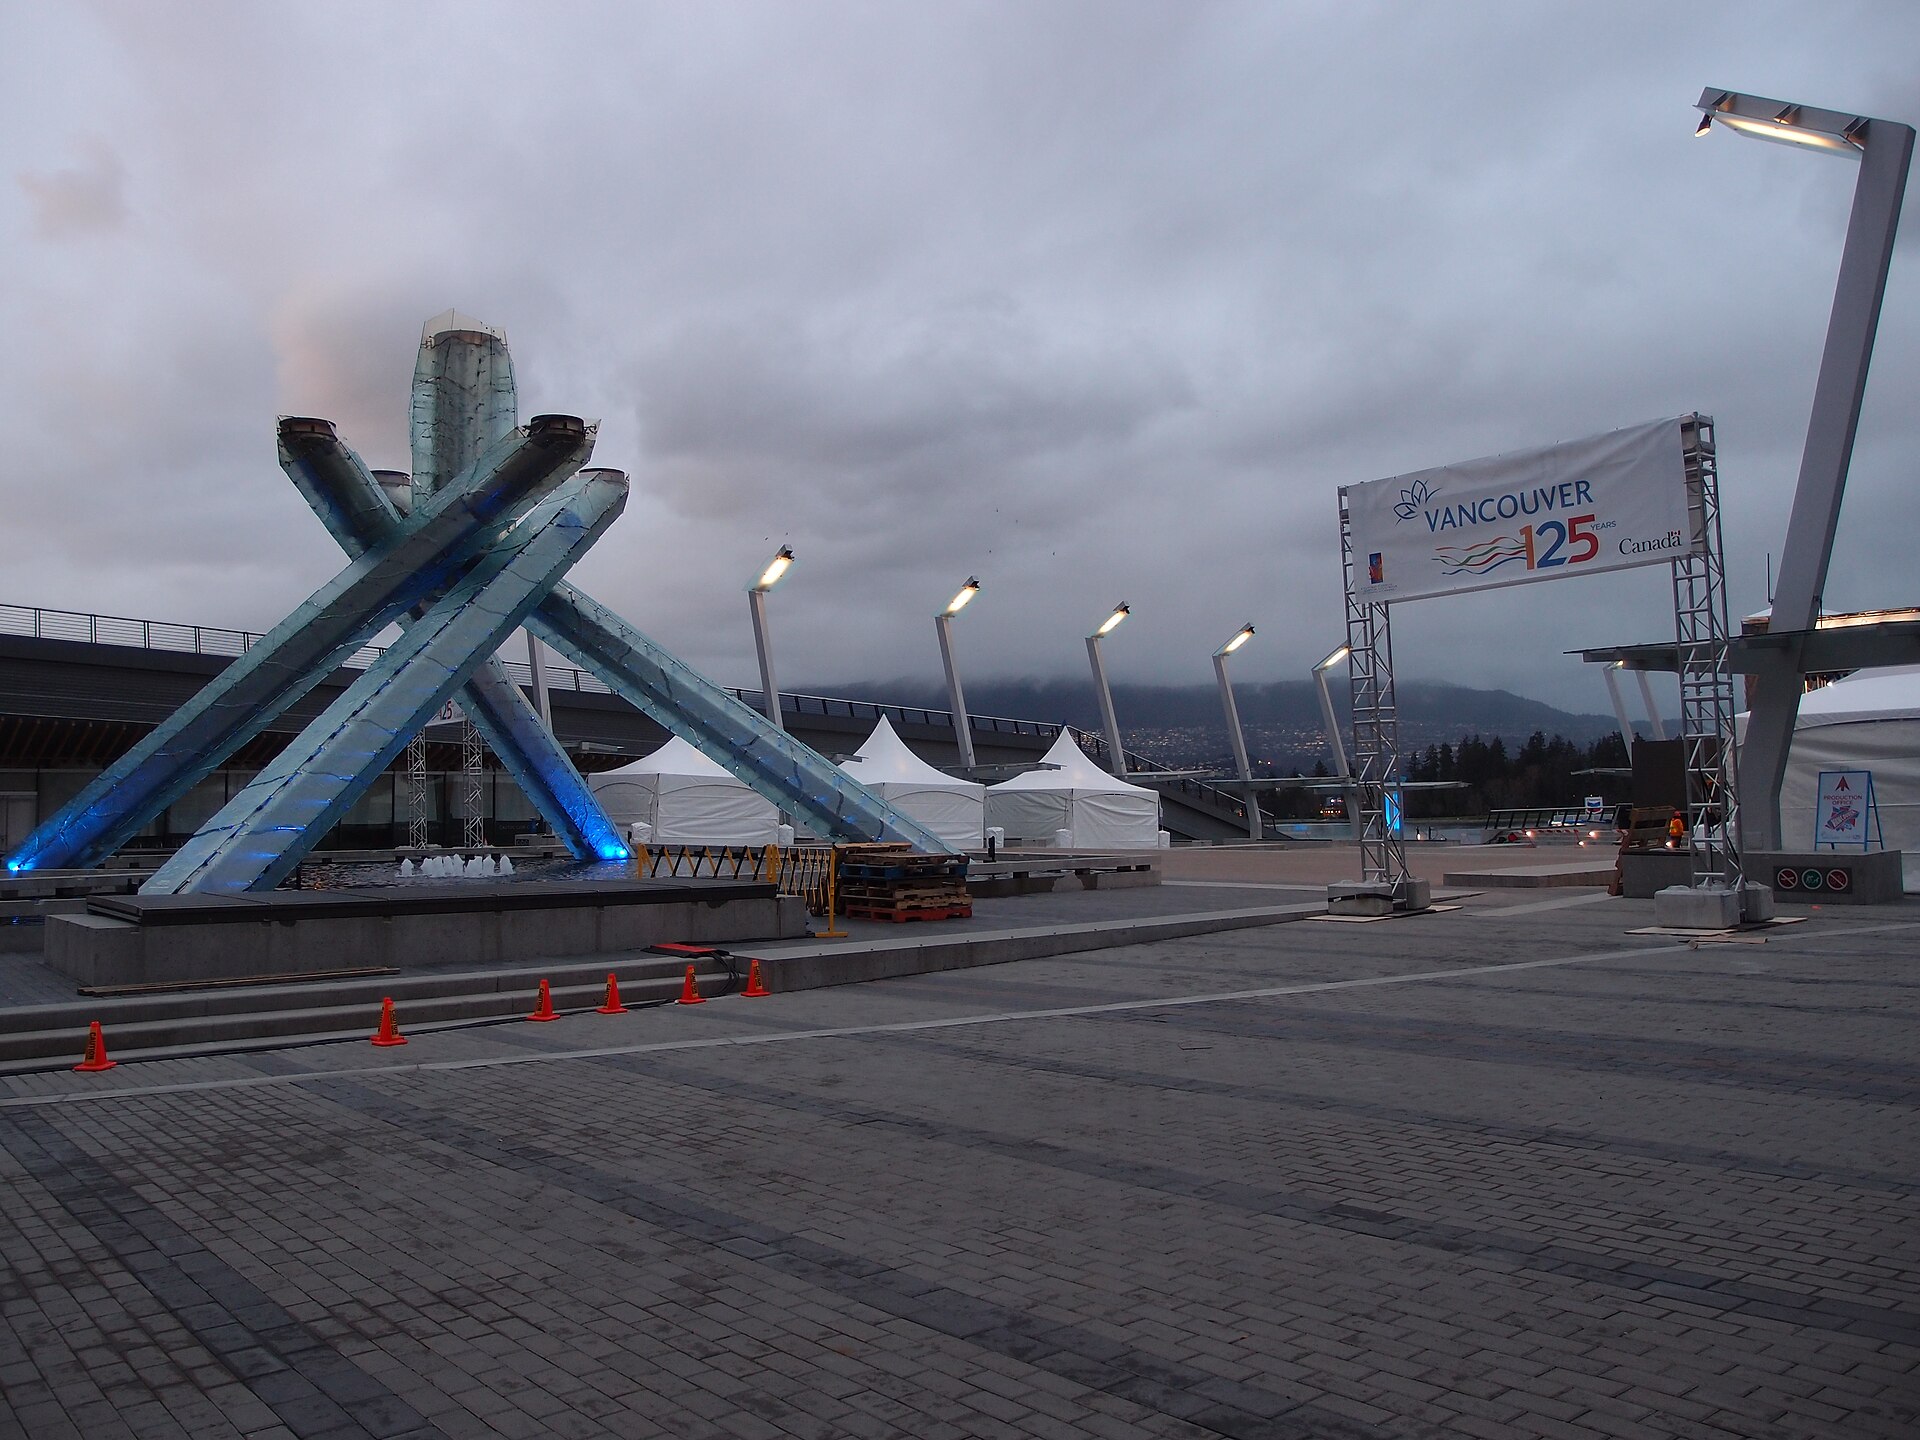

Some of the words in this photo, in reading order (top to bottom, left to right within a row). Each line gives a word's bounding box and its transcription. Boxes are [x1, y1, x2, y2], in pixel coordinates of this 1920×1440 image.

[1424, 480, 1593, 532] VANCOUVER
[1519, 514, 1599, 570] 125
[1590, 521, 1617, 531] YEARS
[1619, 531, 1682, 555] Canada
